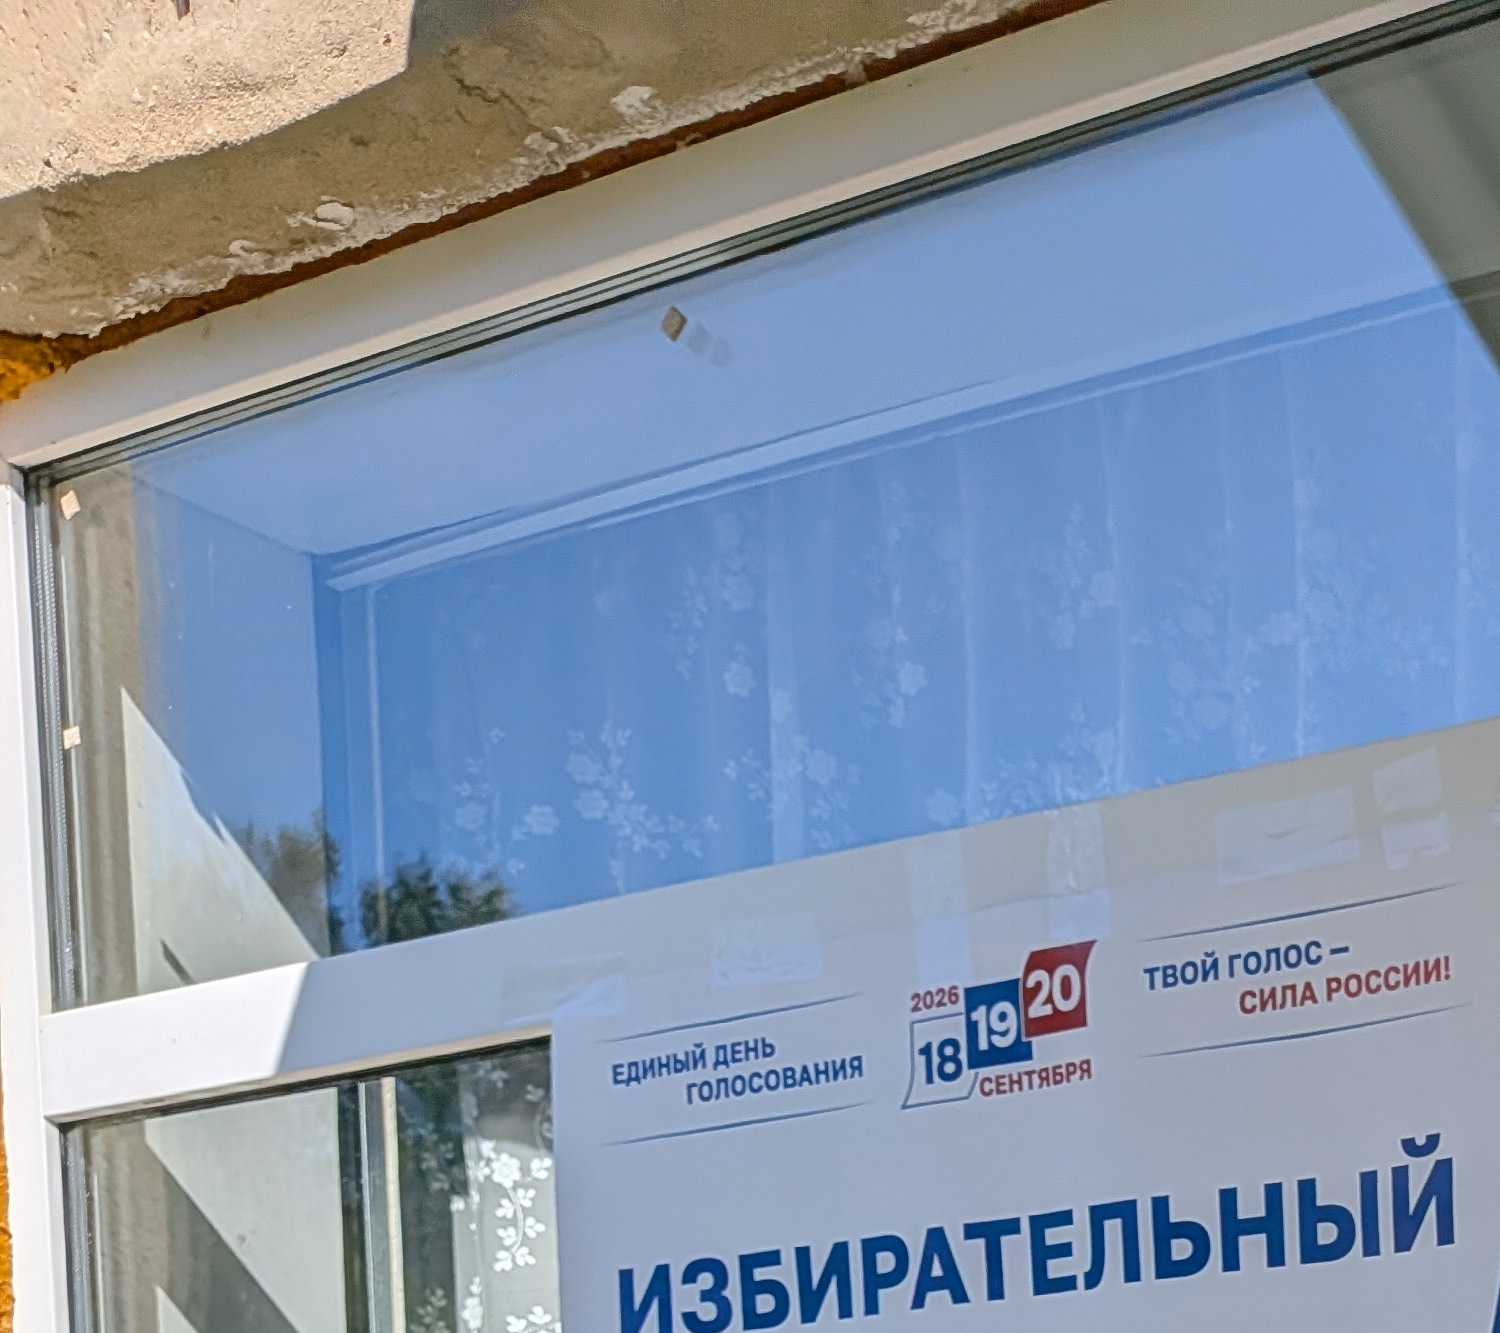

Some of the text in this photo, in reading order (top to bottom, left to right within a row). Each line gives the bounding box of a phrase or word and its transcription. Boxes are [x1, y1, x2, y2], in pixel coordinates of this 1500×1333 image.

[1143, 950, 1219, 991] ТВОЙ
[1228, 940, 1323, 978] ГОЛОС
[1239, 955, 1451, 1014] СИЛА РОССИИ!
[910, 985, 959, 1012] 2026
[918, 964, 1082, 1084] 18 19 20
[611, 1037, 776, 1086] ЕДИНЫЙ ДЕНЬ
[686, 1055, 864, 1105] ГОЛОСОВАНИЯ
[979, 1059, 1093, 1097] СЕНТЯБРЯ
